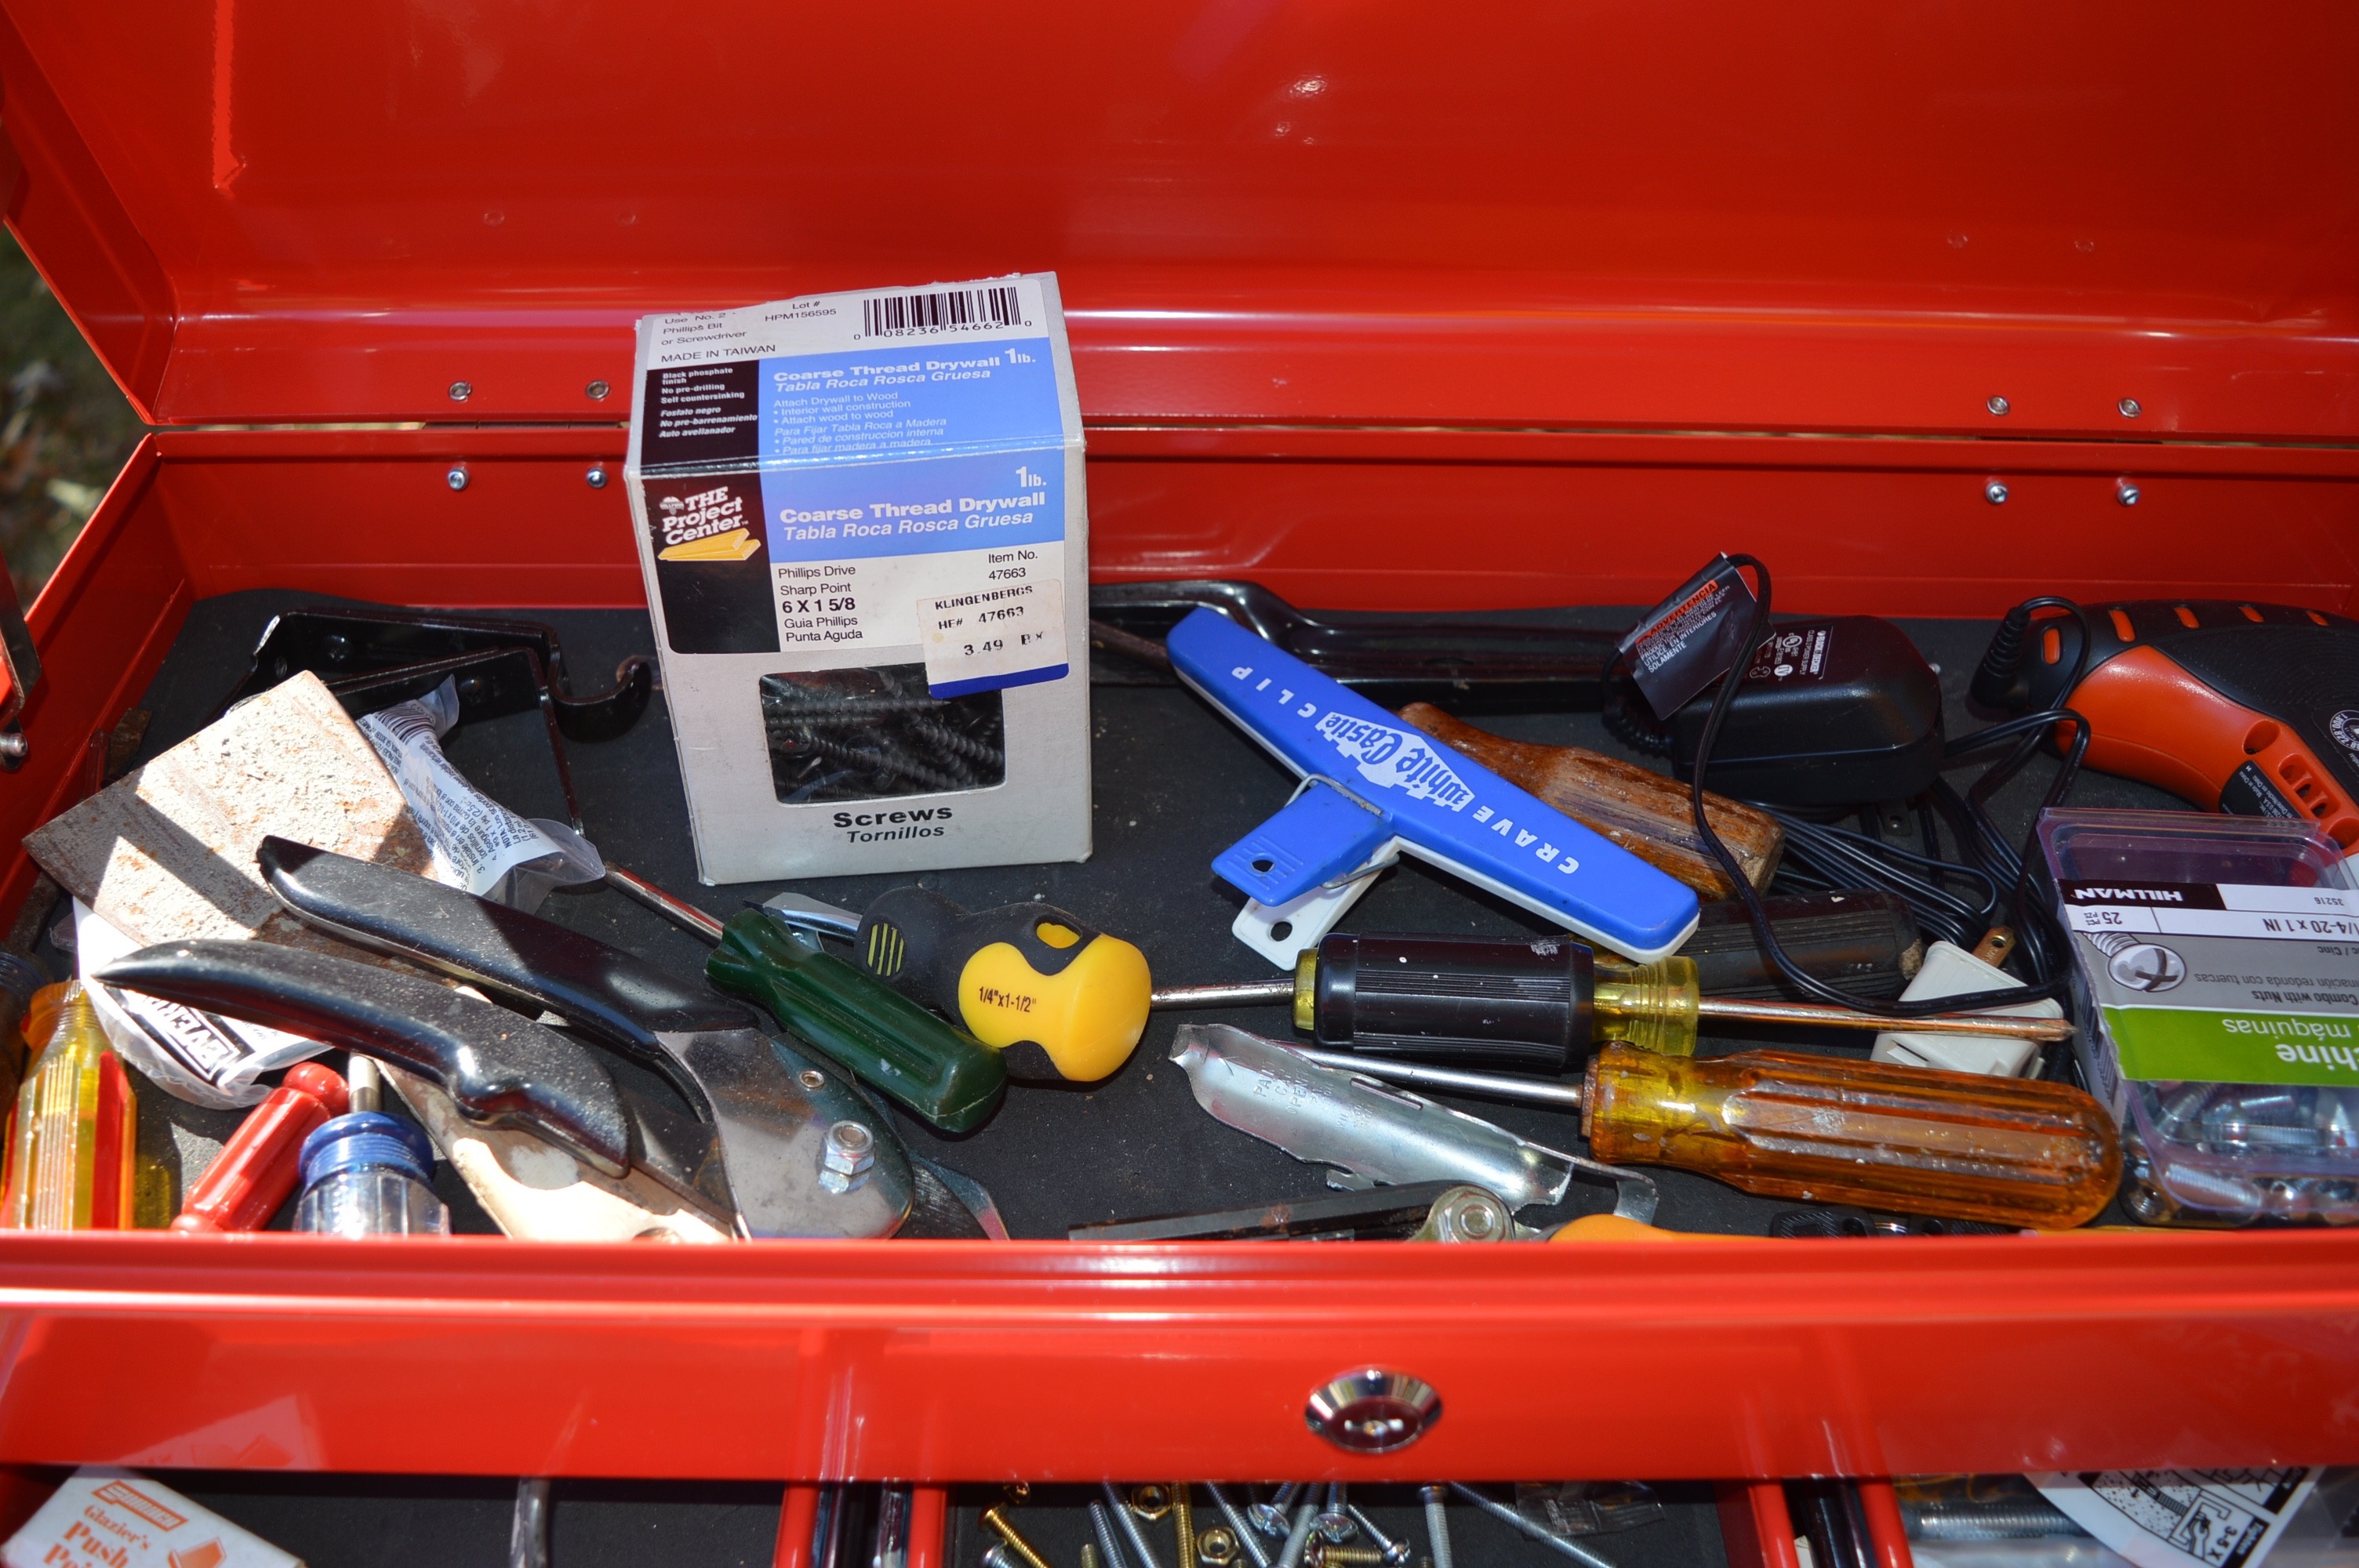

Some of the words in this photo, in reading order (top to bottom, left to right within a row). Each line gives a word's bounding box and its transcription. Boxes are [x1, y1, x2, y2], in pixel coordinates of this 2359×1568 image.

[664, 314, 688, 325] Use
[765, 308, 837, 322] HPM156595
[663, 324, 704, 335] Phillips
[707, 321, 723, 330] Bit
[883, 326, 939, 338] 08236
[949, 321, 1004, 332] 54662
[677, 332, 747, 344] Screwdriver
[660, 352, 702, 363] MADE
[706, 350, 719, 358] IN
[723, 344, 776, 357] TAIWAN
[688, 367, 733, 378] phosphate
[773, 368, 845, 383] Coarse
[849, 362, 921, 376] Thread
[925, 357, 1001, 372] Drywall
[662, 377, 687, 386] finish
[776, 379, 821, 393] Tabla
[825, 377, 869, 389] Roca
[873, 373, 926, 386] Rosca
[931, 368, 991, 383] Gruesa
[675, 383, 725, 394] pre-drilling
[660, 396, 678, 405] Self
[680, 391, 745, 403] countersinking
[773, 398, 808, 408] Attach
[811, 394, 850, 407] Drywall
[866, 391, 899, 401] Wood
[660, 408, 693, 417] Fosfato
[695, 406, 722, 415] negro
[781, 406, 819, 416] Interior
[822, 404, 843, 413] wall
[845, 400, 911, 412] construction
[674, 414, 758, 428] pre-barrenamiento
[781, 415, 816, 425] Attach
[818, 412, 849, 423] wood
[851, 412, 862, 420] to
[863, 410, 894, 419] wood
[659, 430, 681, 438] Auto
[682, 426, 736, 437] avellanador
[774, 427, 801, 437] Para
[803, 425, 828, 436] Fijar
[831, 423, 861, 432] Tabla
[864, 421, 892, 430] Roca
[905, 418, 947, 427] Madera
[782, 435, 816, 445] Pared
[818, 434, 833, 443] de
[834, 429, 903, 442] construccion
[906, 427, 944, 437] interna
[783, 445, 809, 456] Para
[812, 444, 832, 454] fijar
[834, 442, 877, 452] madera
[889, 438, 932, 447] madera
[684, 486, 729, 511] THE
[662, 496, 743, 533] Project
[779, 507, 864, 524] Coarse
[869, 499, 952, 518] Thread
[958, 491, 1046, 513] Drywall
[665, 514, 743, 545] Center
[783, 524, 837, 541] Tabla
[842, 521, 892, 538] Roca
[897, 517, 959, 535] Rosca
[964, 512, 1034, 529] Gruesa
[988, 553, 1014, 564] Item
[1017, 550, 1038, 561] No.
[778, 567, 821, 580] Phillips
[823, 564, 856, 576] Drive
[988, 567, 1027, 580] 47663
[780, 585, 817, 597] Sharp
[820, 582, 852, 593] Point
[935, 585, 1034, 610] KLINGENBERGS
[782, 601, 793, 614] 6
[797, 600, 810, 613] X
[814, 599, 823, 612] 1
[828, 597, 856, 612] 5/8
[1650, 583, 1716, 636] ADVERTENCIA
[783, 618, 813, 629] Guia
[816, 616, 858, 628] Phillips
[938, 618, 963, 630] HF#
[978, 605, 1024, 623] 47663
[1679, 611, 1717, 641] INTERIORES
[786, 632, 822, 642] Punta
[823, 629, 863, 643] Aguda
[1648, 641, 1687, 673] SOLAMENTE
[1230, 663, 1317, 719] CLIP
[1325, 713, 1404, 766] Castle
[1395, 747, 1470, 805] White
[467, 818, 475, 828] la
[832, 804, 954, 829] Screws
[459, 823, 468, 834] de
[846, 823, 946, 844] Tornillos
[455, 833, 463, 845] en
[474, 826, 496, 853] Asegure
[499, 827, 511, 849] NOTA:
[1470, 803, 1581, 875] CRAVE
[461, 840, 480, 866] Instale
[477, 864, 485, 873] 3.
[2073, 887, 2184, 902] HILLMAN
[2314, 896, 2346, 907] 35216
[2083, 911, 2098, 920] PZS
[2086, 918, 2101, 927] PCS
[2101, 911, 2123, 925] 25
[2262, 917, 2281, 932] IN
[2288, 919, 2295, 932] 1
[2300, 919, 2308, 930] x
[2317, 946, 2343, 956] Cinc
[2194, 971, 2237, 983] tuercas
[2239, 975, 2263, 985] con
[2264, 975, 2315, 987] redonda
[2252, 989, 2282, 1004] Nuts
[2285, 990, 2312, 1004] with
[2314, 991, 2359, 1006] Combo
[2222, 1018, 2351, 1041] máquinas
[1285, 1068, 1310, 1116] OPENER
[82, 1504, 151, 1552] Glazier's
[63, 1519, 129, 1568] Push
